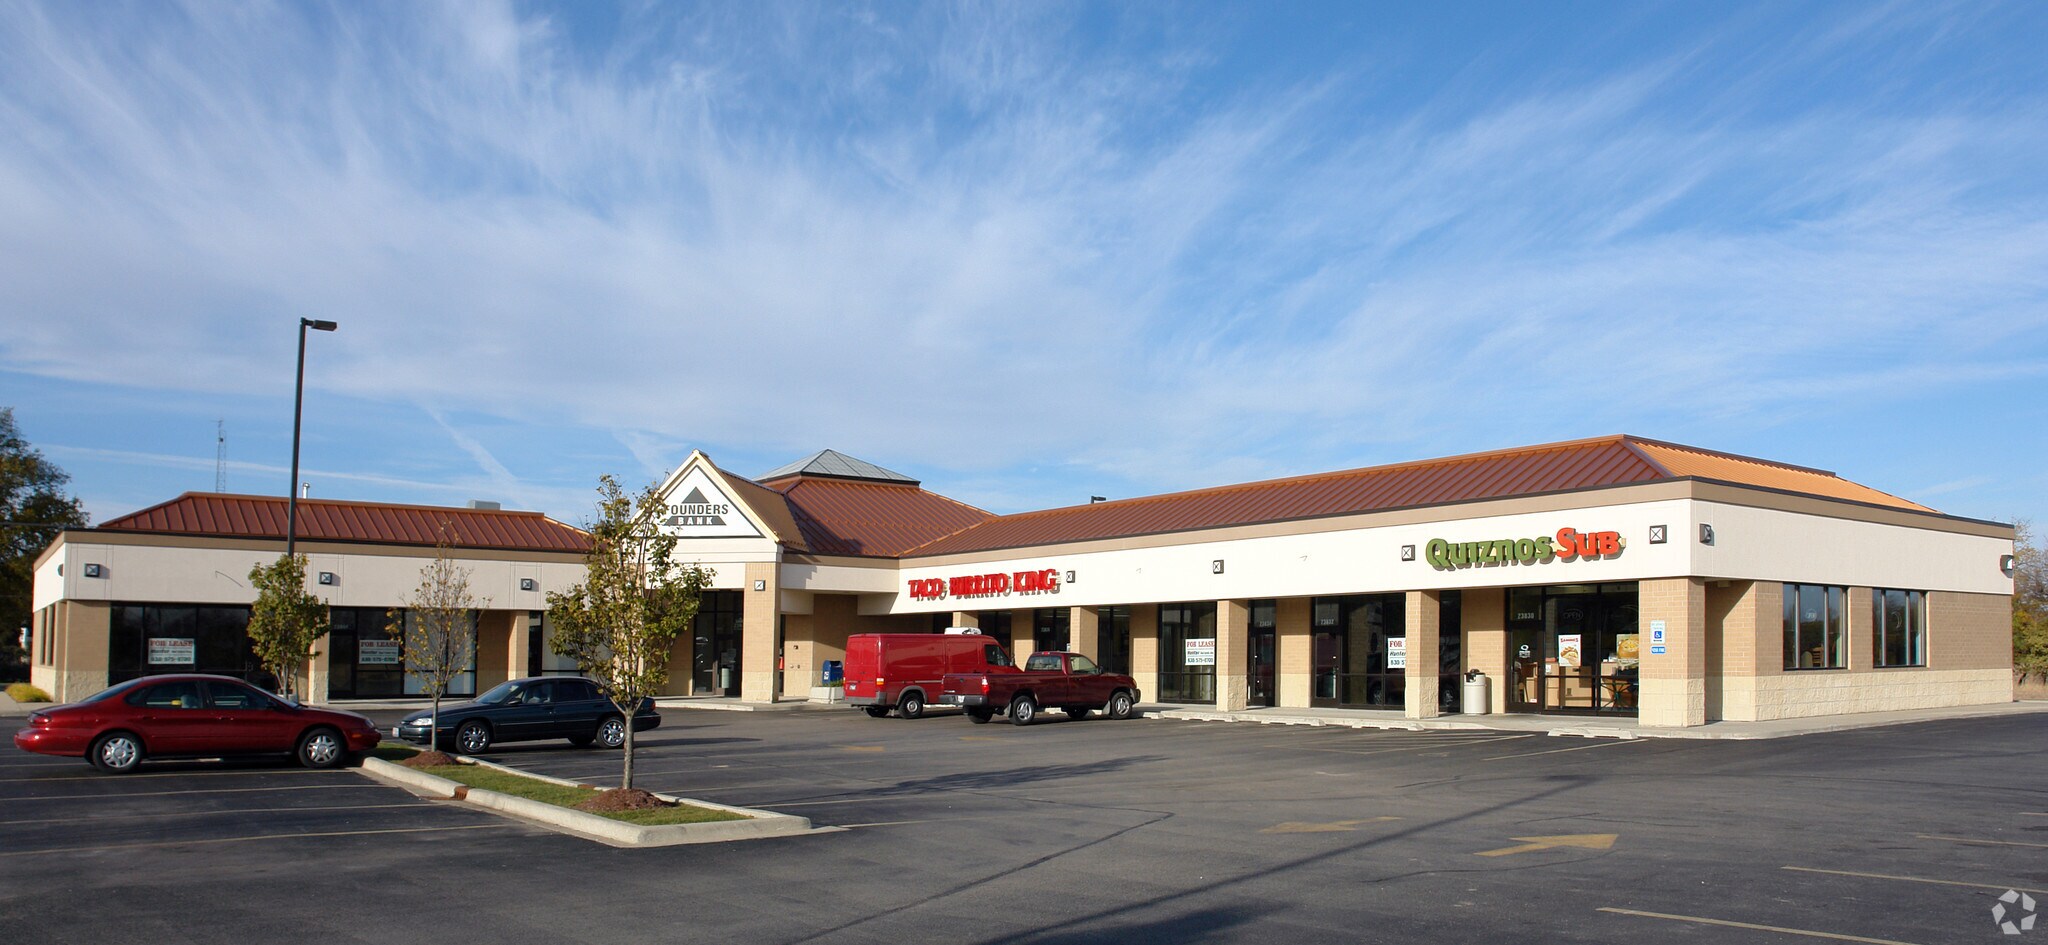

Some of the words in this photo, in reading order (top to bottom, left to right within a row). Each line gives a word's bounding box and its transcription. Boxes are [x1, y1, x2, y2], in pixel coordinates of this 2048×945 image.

[677, 516, 713, 525] BANK
[908, 578, 944, 598] TACO
[949, 573, 1009, 596] BURRITO
[1012, 568, 1057, 592] KING
[1517, 612, 1535, 620] 23830
[1563, 610, 1581, 619] OPEN
[1198, 640, 1215, 648] LEASE
[1389, 640, 1403, 648] FOR
